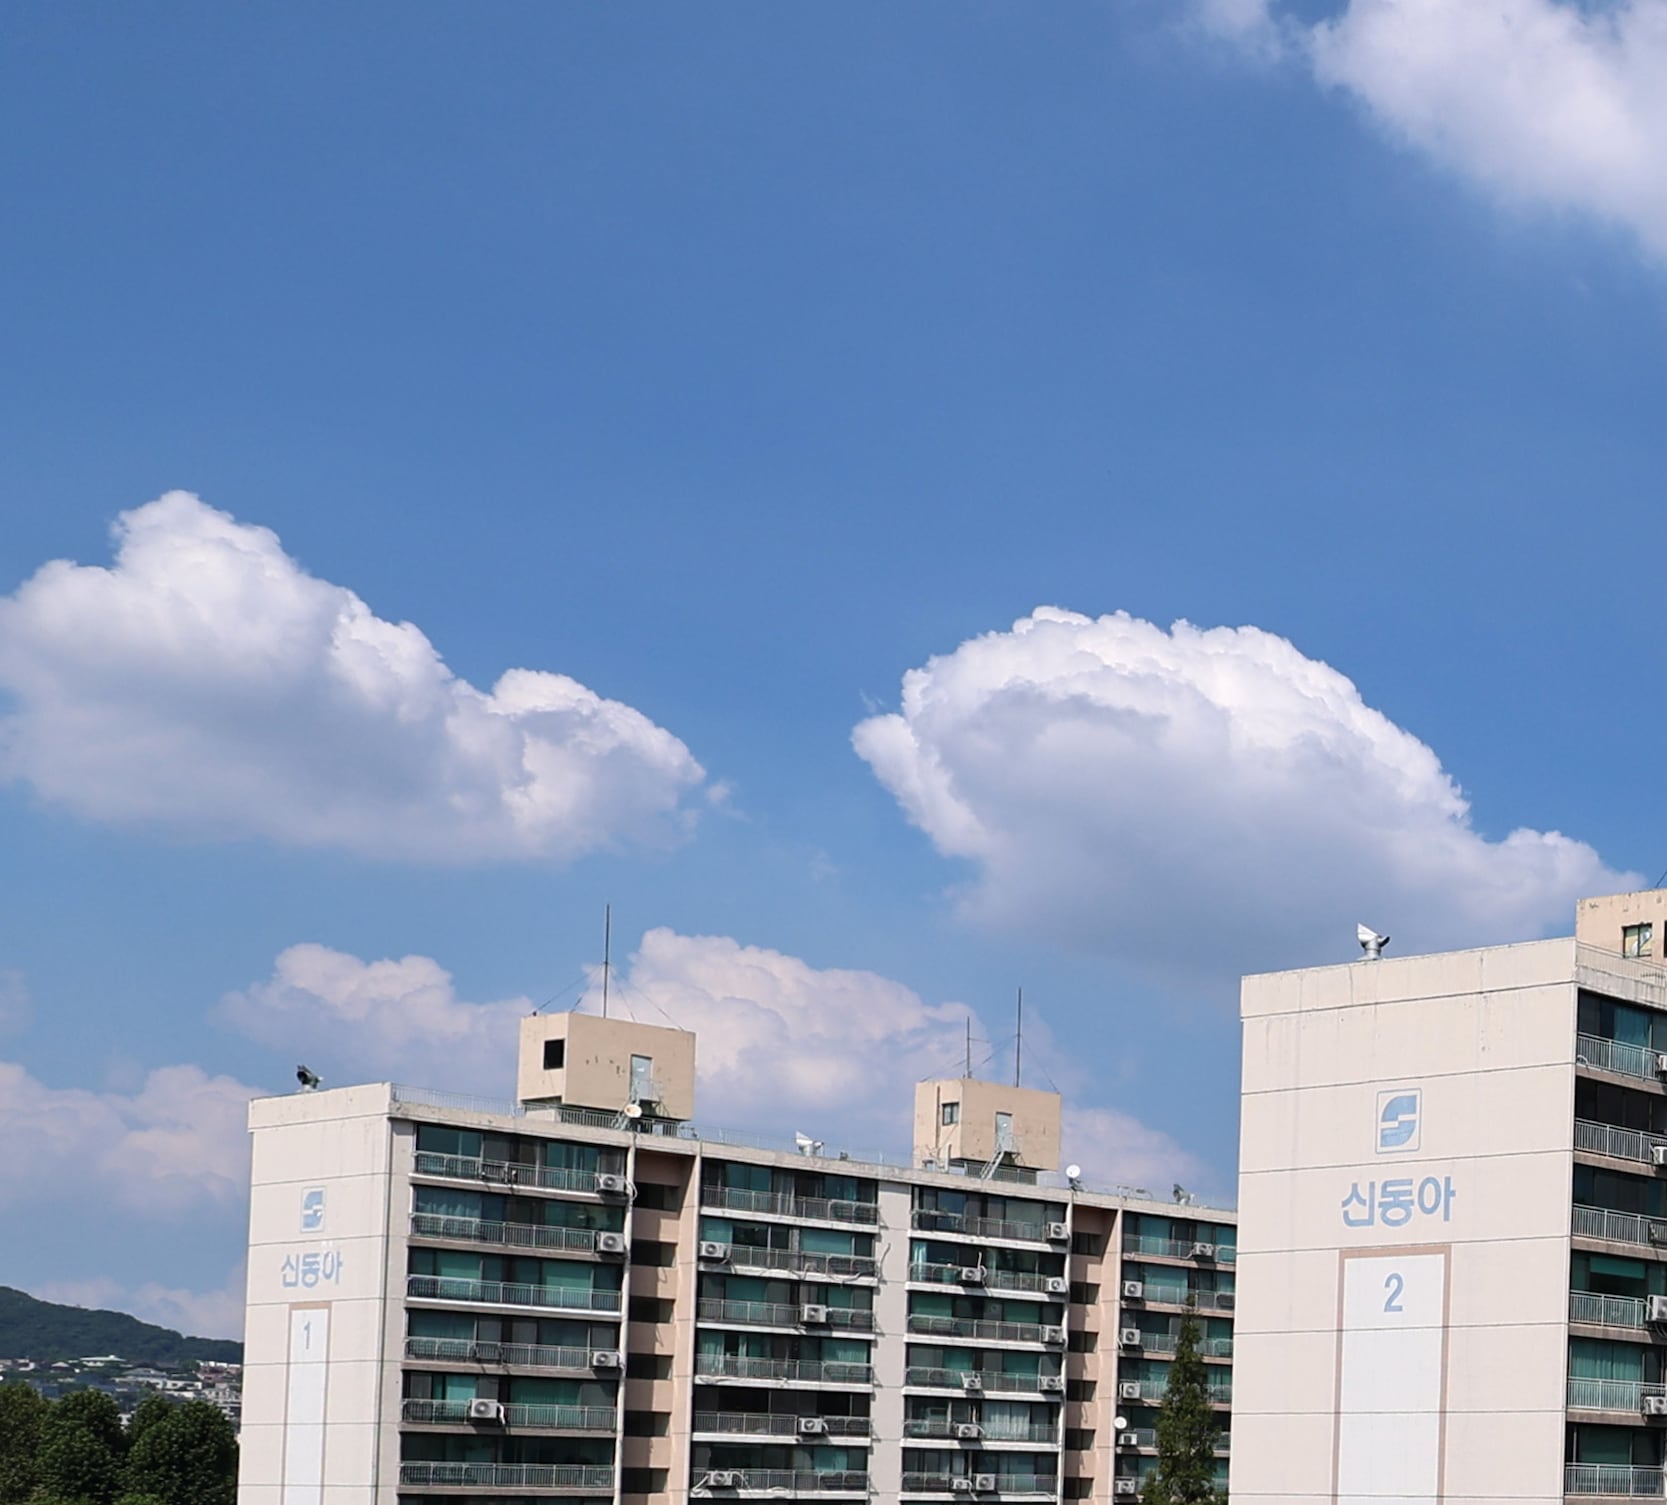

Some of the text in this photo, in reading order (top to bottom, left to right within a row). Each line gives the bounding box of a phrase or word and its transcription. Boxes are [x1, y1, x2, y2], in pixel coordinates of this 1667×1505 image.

[1341, 1175, 1457, 1228] 신동아
[281, 1251, 343, 1288] 신동아
[1383, 1272, 1404, 1313] 2
[303, 1320, 311, 1350] 1
